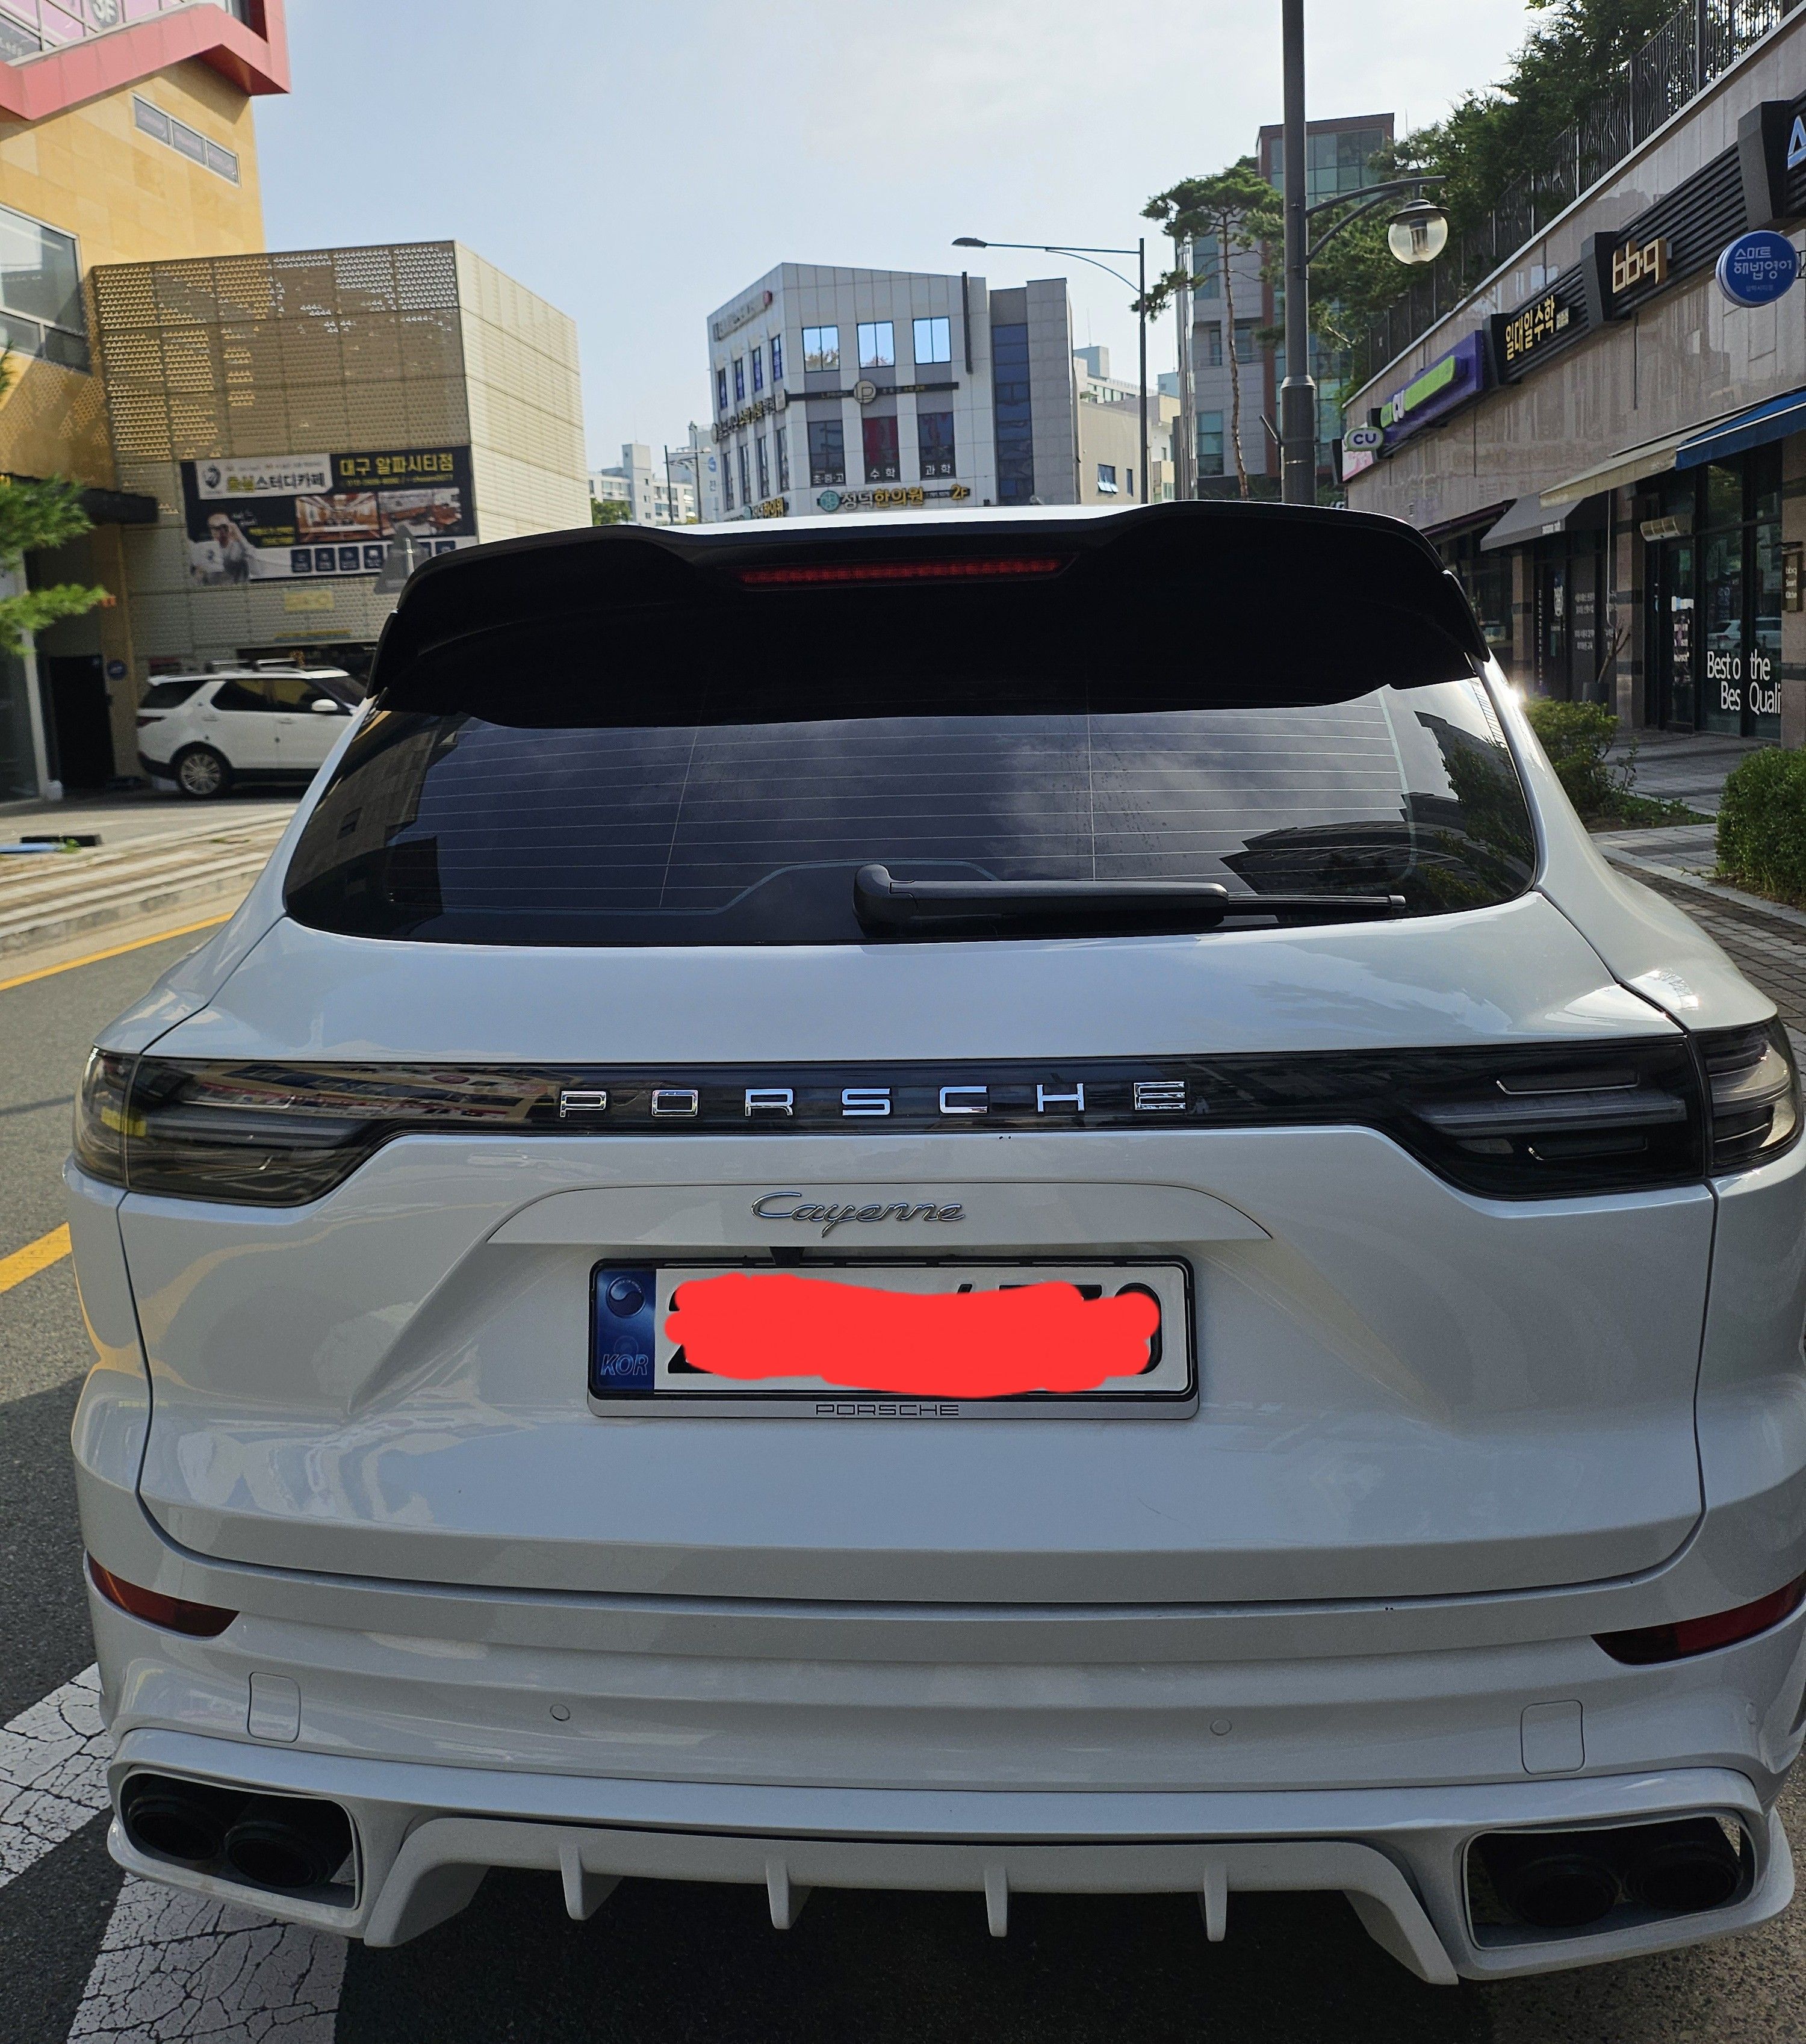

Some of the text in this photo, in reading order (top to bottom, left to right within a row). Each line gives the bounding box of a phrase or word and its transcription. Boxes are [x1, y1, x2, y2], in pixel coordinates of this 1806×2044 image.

[1734, 259, 1792, 280] 해법영어
[1506, 294, 1555, 361] 일대일수학
[1353, 433, 1377, 445] CU
[339, 458, 371, 477] 대구
[375, 453, 454, 475] 알파시티점
[841, 484, 969, 510] 정덕한의원 2F
[1707, 648, 1771, 681] Best o the
[1721, 680, 1781, 716] Bes Quali
[559, 1081, 1187, 1118] PORSCHE
[751, 1192, 964, 1238] Cayenne
[600, 1354, 648, 1375] KOR
[816, 1404, 959, 1416] PORSCHE
